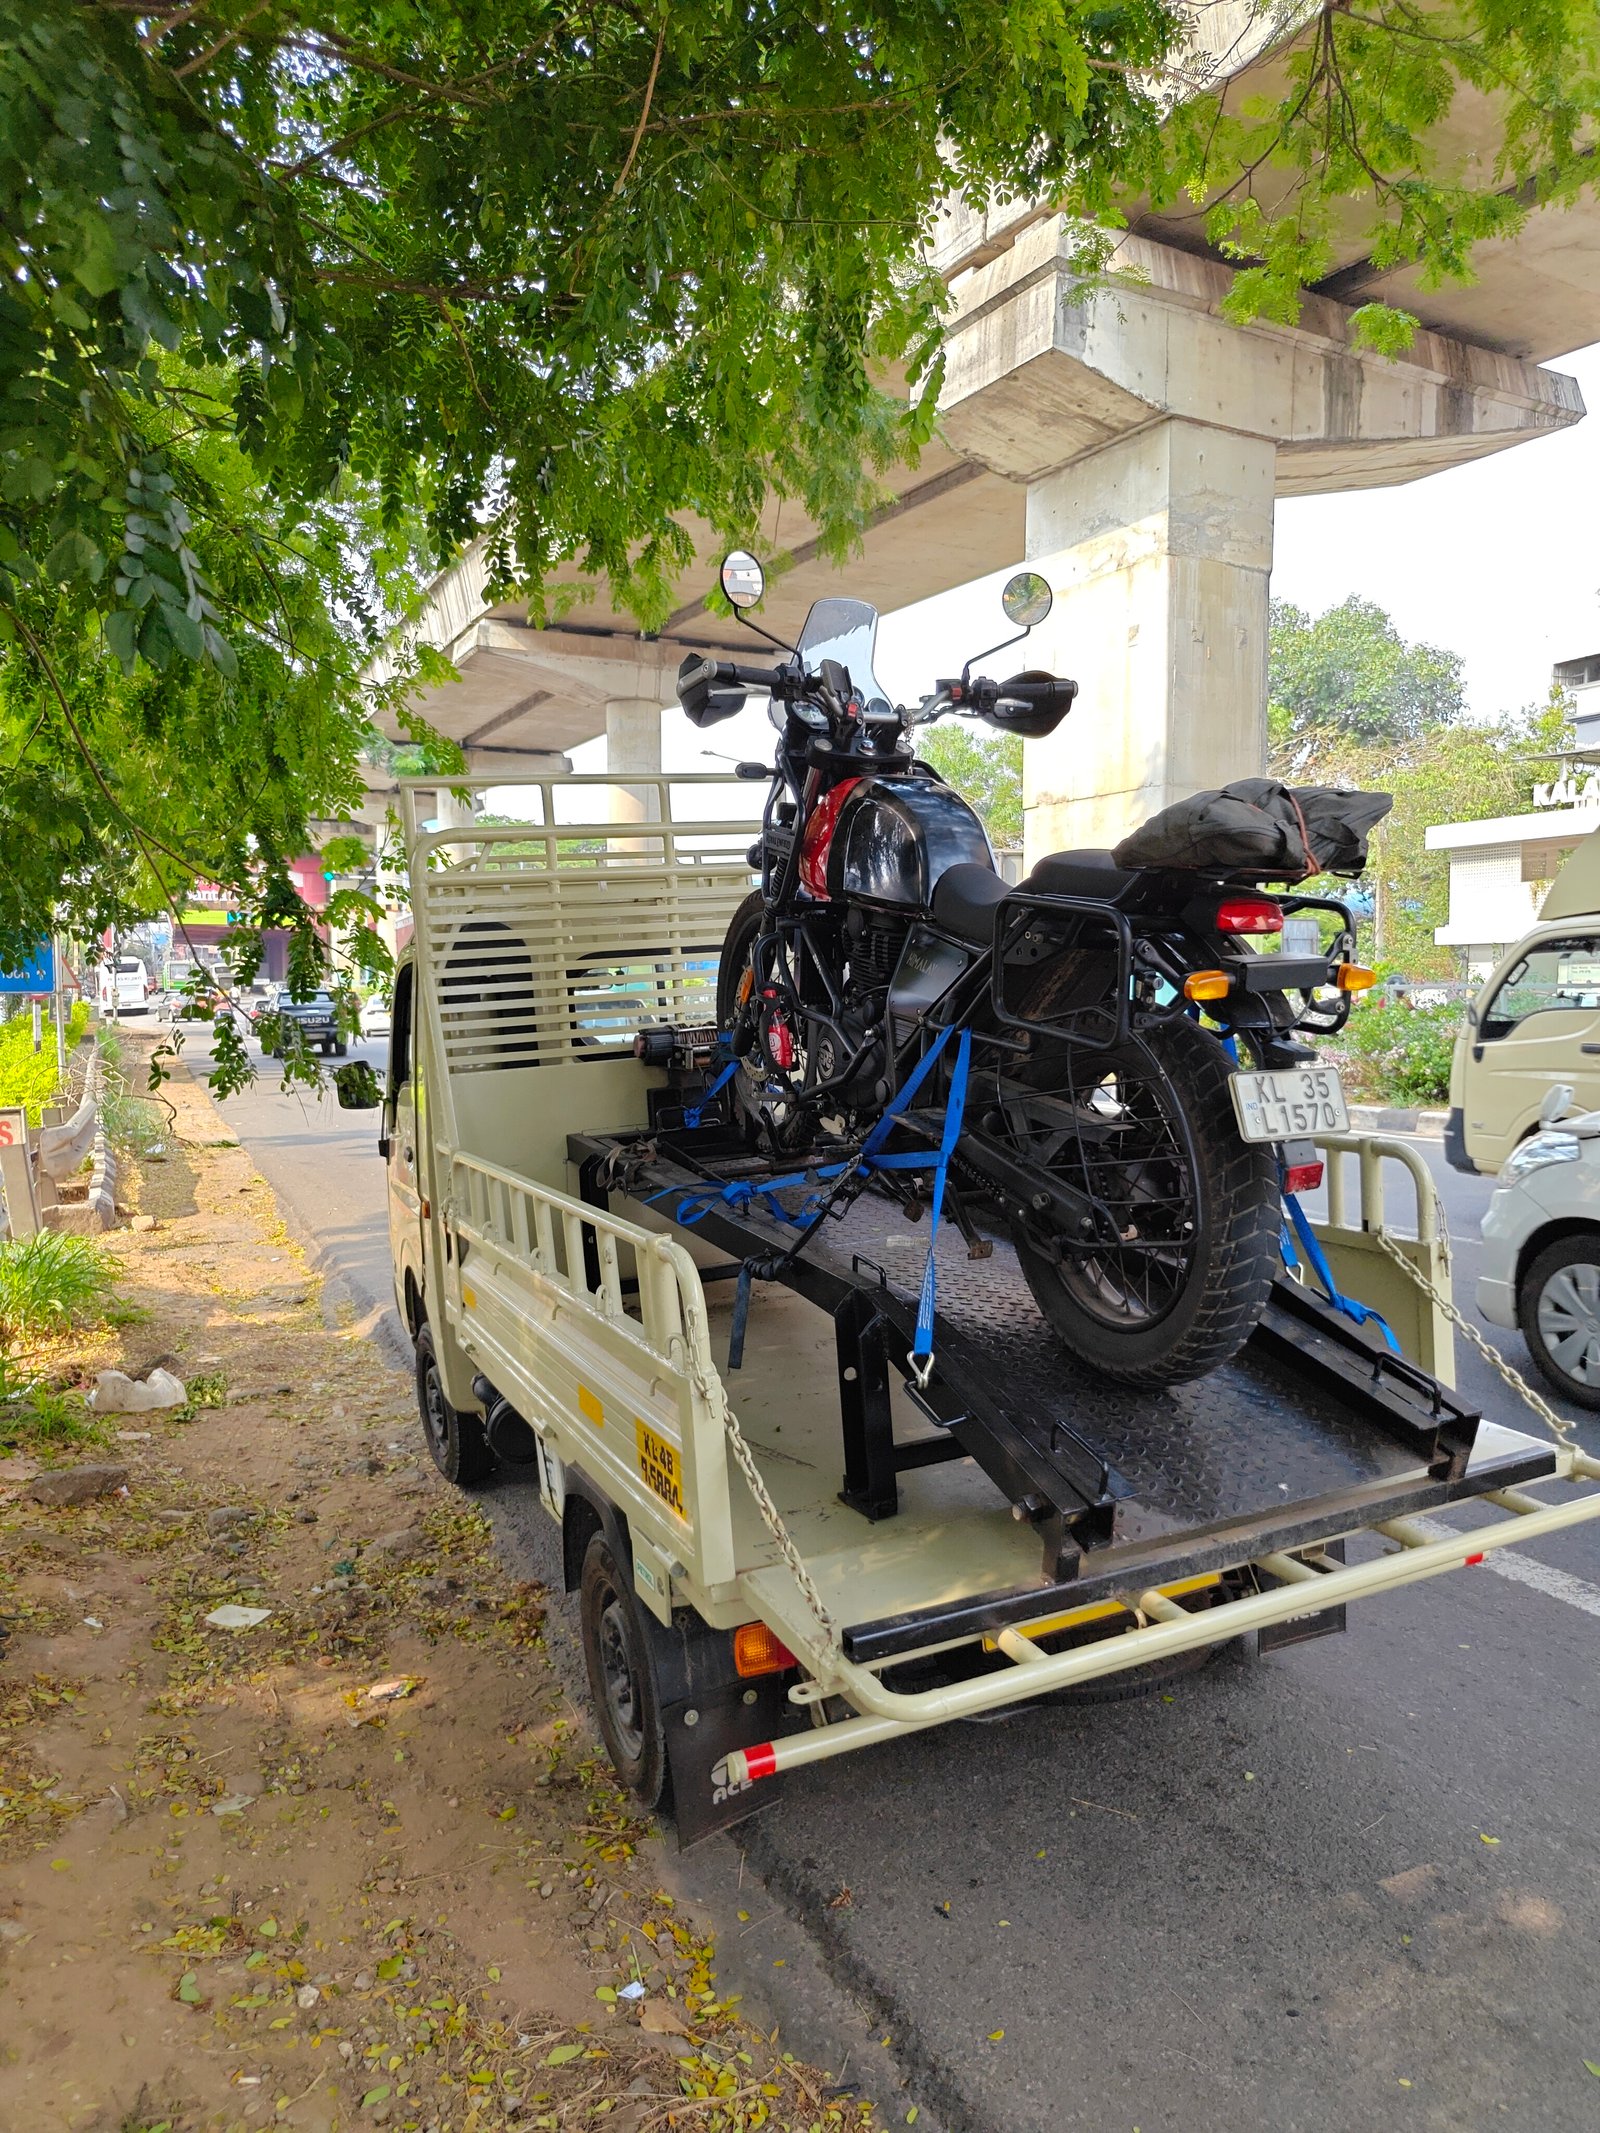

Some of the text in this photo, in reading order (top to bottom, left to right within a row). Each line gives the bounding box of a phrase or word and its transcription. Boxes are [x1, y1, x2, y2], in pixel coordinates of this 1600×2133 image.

[1254, 1072, 1330, 1103] KL 35
[1246, 1103, 1259, 1111] IND
